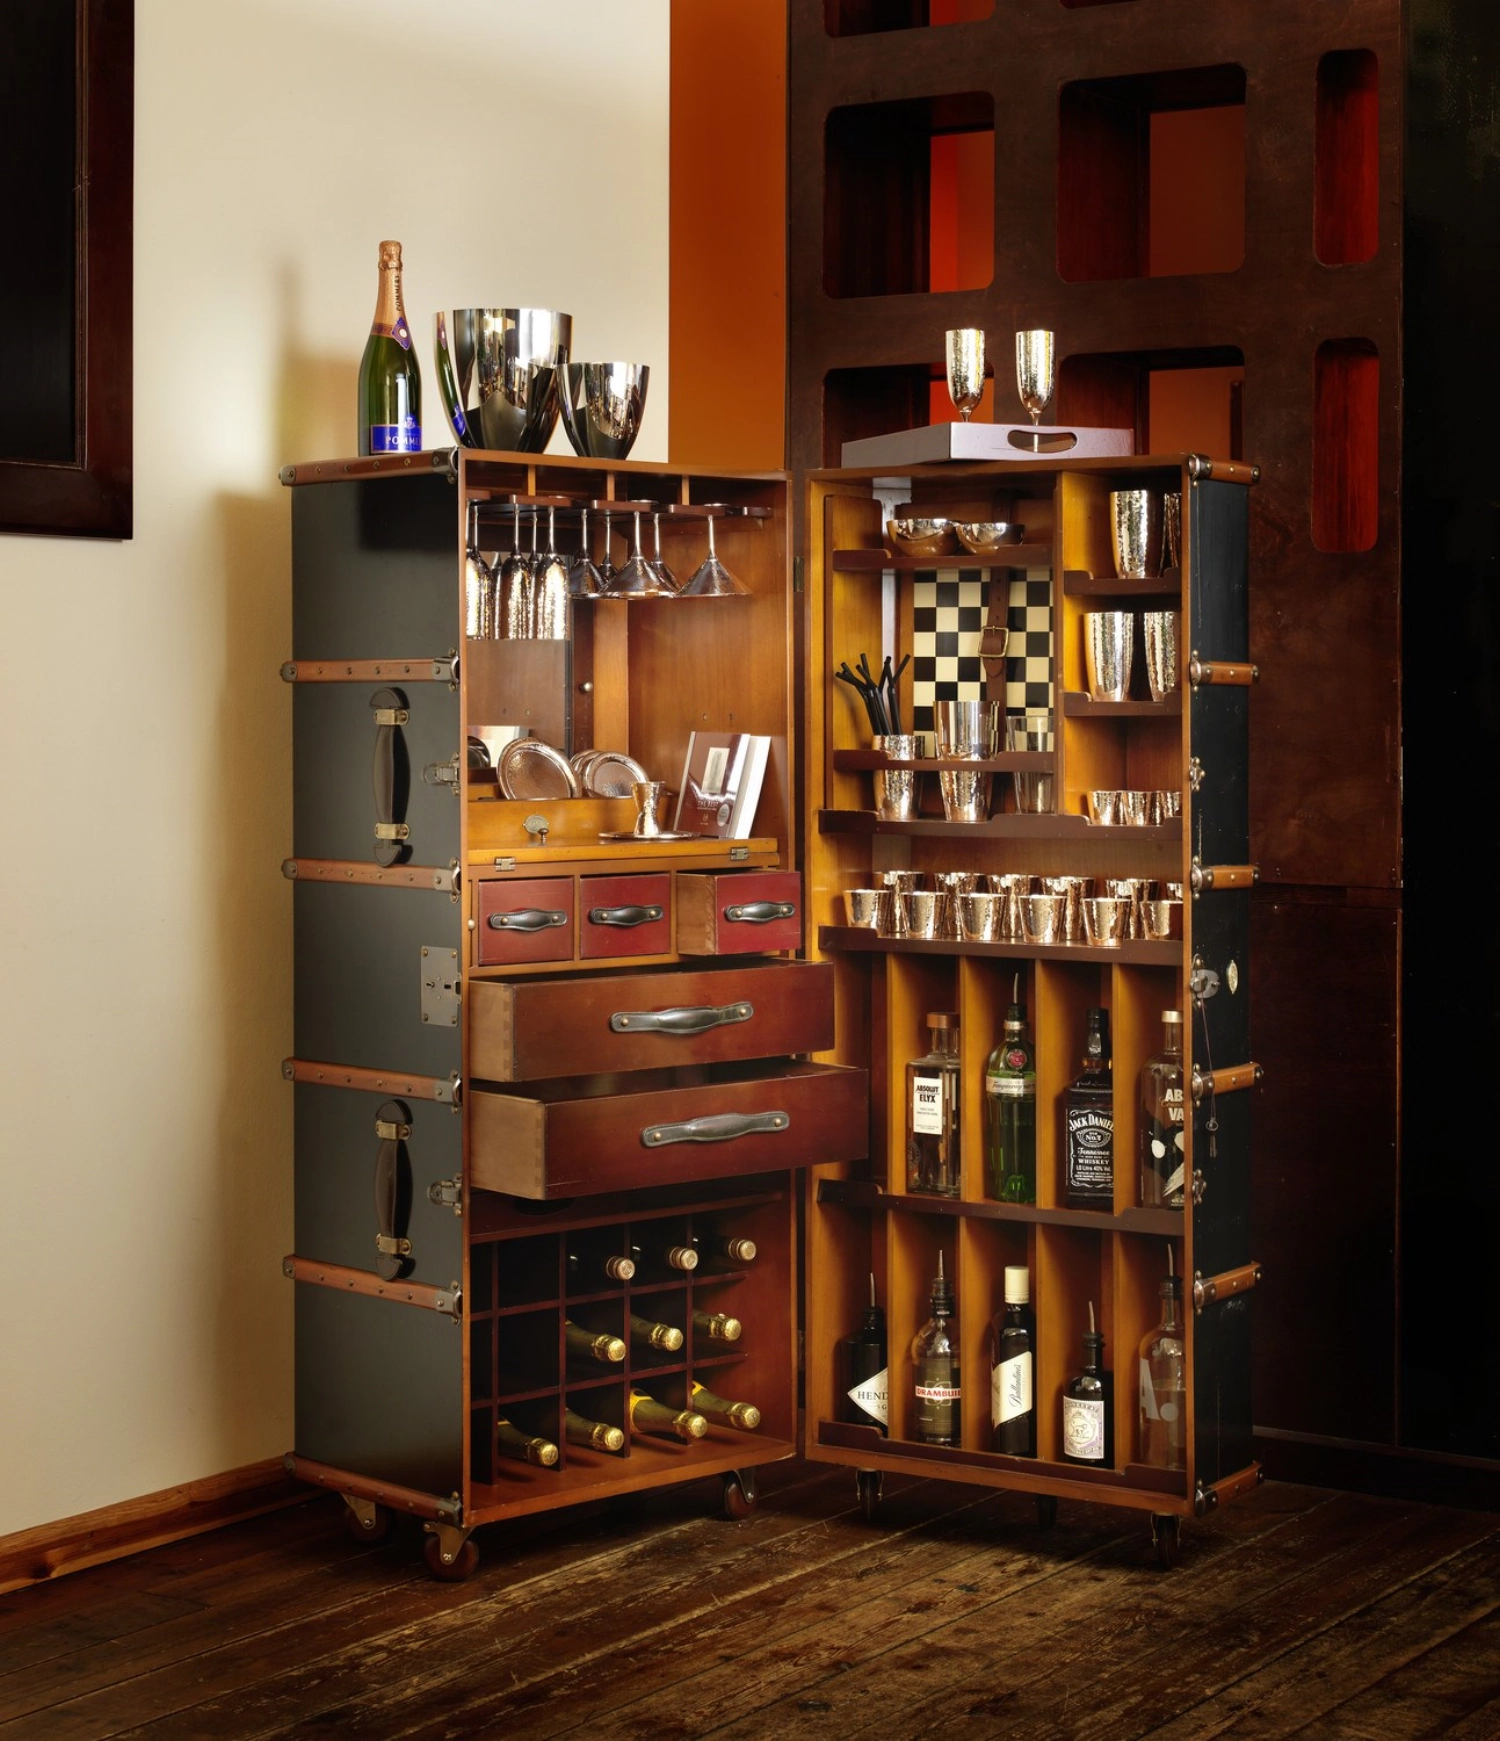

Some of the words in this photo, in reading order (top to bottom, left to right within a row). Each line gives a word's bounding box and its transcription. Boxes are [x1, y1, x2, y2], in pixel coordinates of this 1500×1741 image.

[915, 1084, 939, 1093] ABSOLUT
[919, 1093, 936, 1103] ELYX
[1069, 1116, 1089, 1132] JACK
